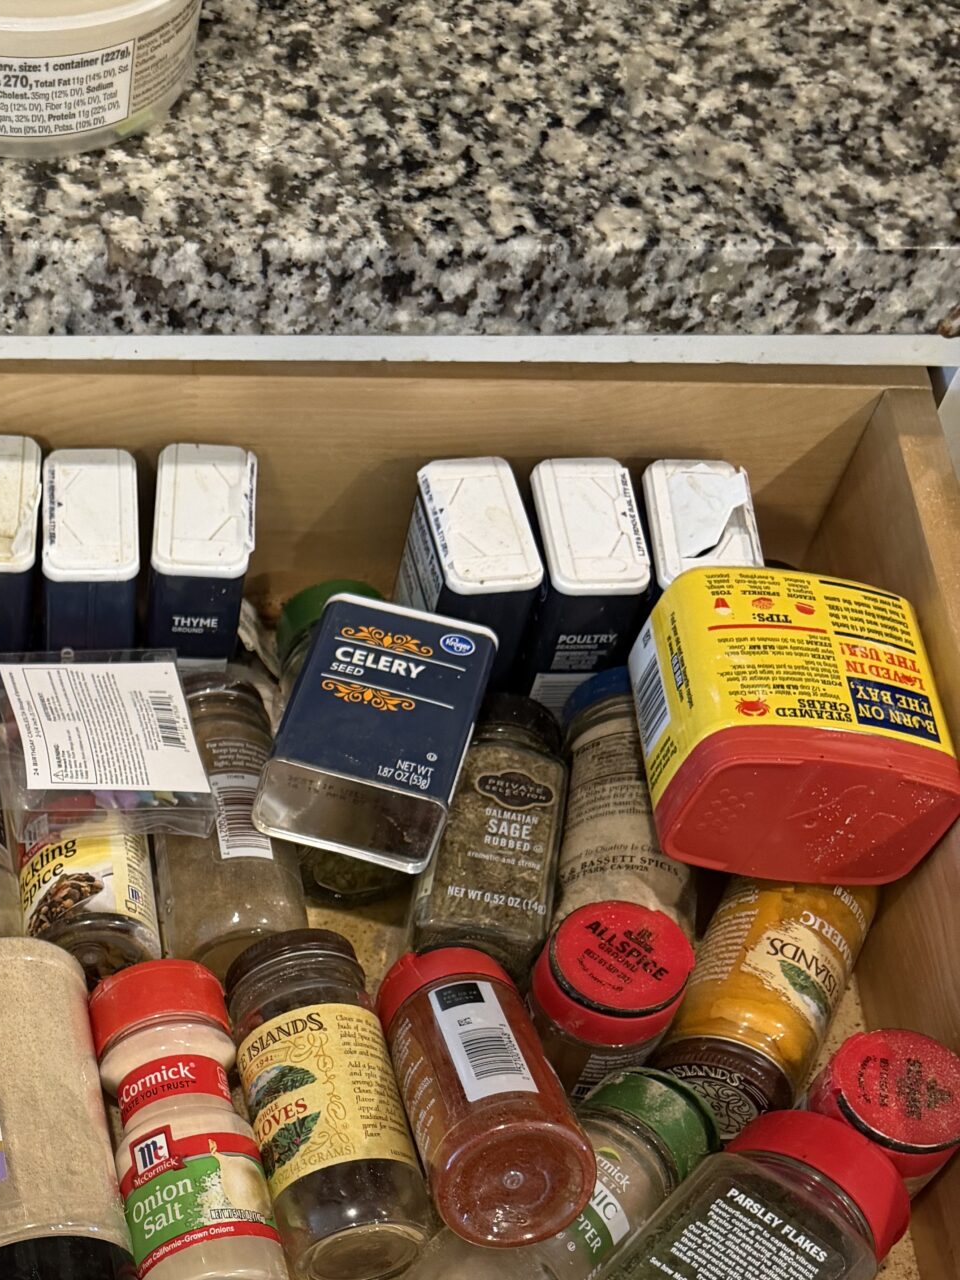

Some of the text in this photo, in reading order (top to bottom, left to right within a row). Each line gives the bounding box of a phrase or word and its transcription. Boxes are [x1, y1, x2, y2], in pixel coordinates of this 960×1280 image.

[19, 62, 41, 72] size:
[44, 63, 49, 71] 1
[53, 57, 99, 71] container
[172, 617, 218, 629] THYME
[752, 613, 792, 623] TIPS:
[557, 634, 617, 645] POULTRY
[335, 647, 426, 679] CELERY
[840, 642, 920, 673] THE USA!
[330, 661, 364, 676] SEED
[846, 661, 865, 673] IN
[798, 699, 849, 712] CRABS
[850, 681, 932, 716] THE BAY,
[776, 707, 853, 722] STEAMED
[858, 704, 884, 720] ON
[377, 765, 431, 789] 1.87 OZ (53g)
[397, 760, 434, 777] NET WT
[485, 785, 546, 800] SELECTION
[488, 778, 543, 794] PRIVATE
[486, 808, 539, 825] DALMATIAN
[488, 819, 531, 840] SAGE
[485, 835, 530, 851] RUBBED
[581, 855, 636, 870] BASSETT
[448, 886, 465, 897] NET
[468, 889, 482, 900] WT
[485, 893, 505, 903] 0.52
[508, 897, 520, 908] OZ
[585, 921, 669, 981] ALLSPICE
[246, 1012, 325, 1062] ISLANDS
[140, 1088, 159, 1100] YOU
[134, 1157, 178, 1187] McCormick
[133, 1178, 193, 1224] Onion
[143, 1202, 184, 1240] Salt
[726, 1187, 827, 1262] PARSLEY FLAKES
[153, 1225, 235, 1261] California-Grown Onions
